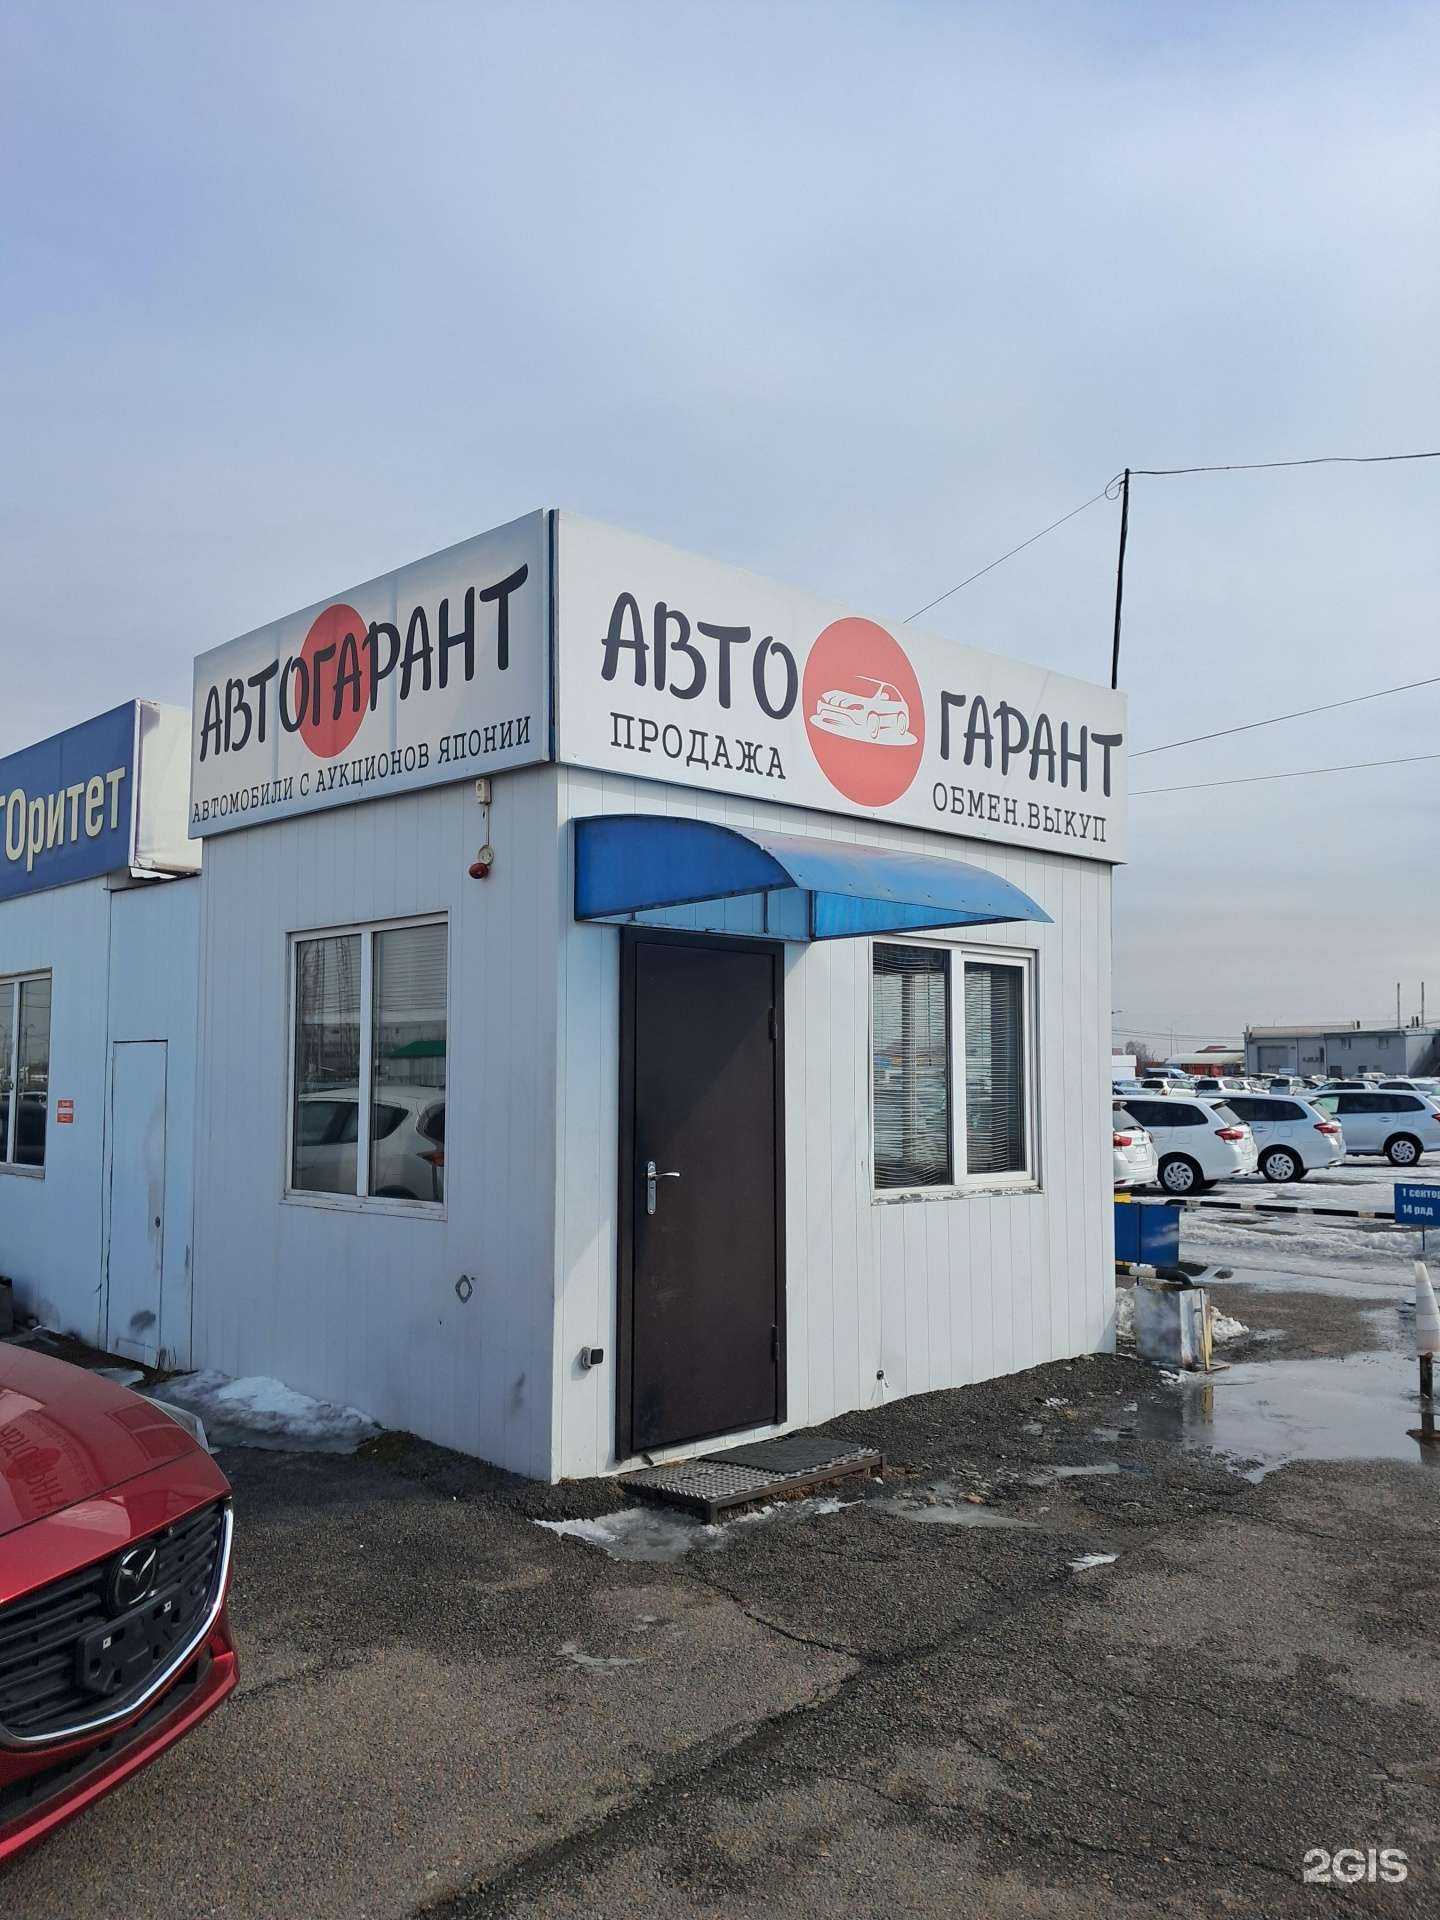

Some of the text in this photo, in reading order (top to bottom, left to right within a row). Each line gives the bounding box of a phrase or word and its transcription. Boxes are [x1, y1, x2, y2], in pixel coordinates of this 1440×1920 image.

[200, 563, 528, 762] АВТОГАРАНТ
[601, 591, 798, 720] АВТО
[192, 716, 532, 823] АВТОМОБИЛИ С АУКЦИОНОВ ЯПОНИИ
[610, 711, 786, 780] ПРОДАЖА
[940, 690, 1123, 797] ГАРАНТ
[1402, 1188, 1407, 1196] 1
